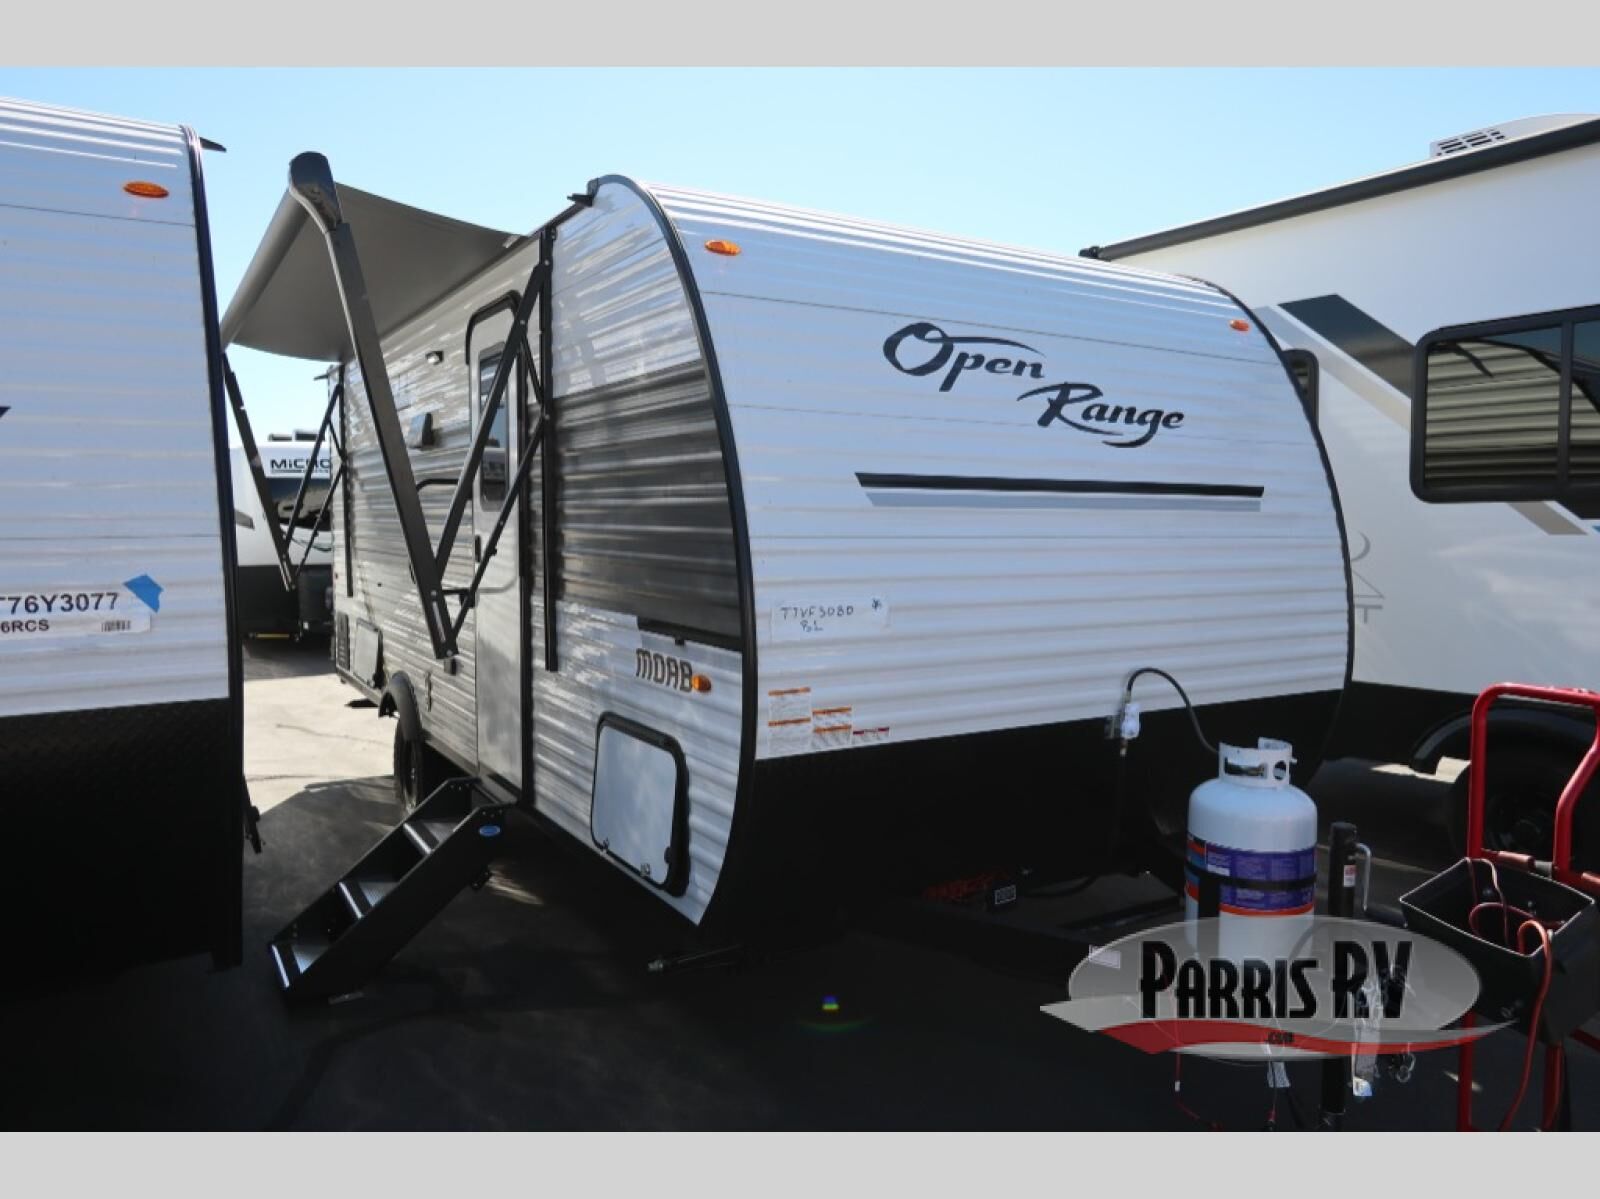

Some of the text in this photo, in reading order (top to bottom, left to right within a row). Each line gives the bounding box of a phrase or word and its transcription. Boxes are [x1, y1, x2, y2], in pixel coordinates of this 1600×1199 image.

[883, 322, 1045, 393] Open
[1017, 383, 1184, 448] Range
[636, 648, 693, 692] MOAB
